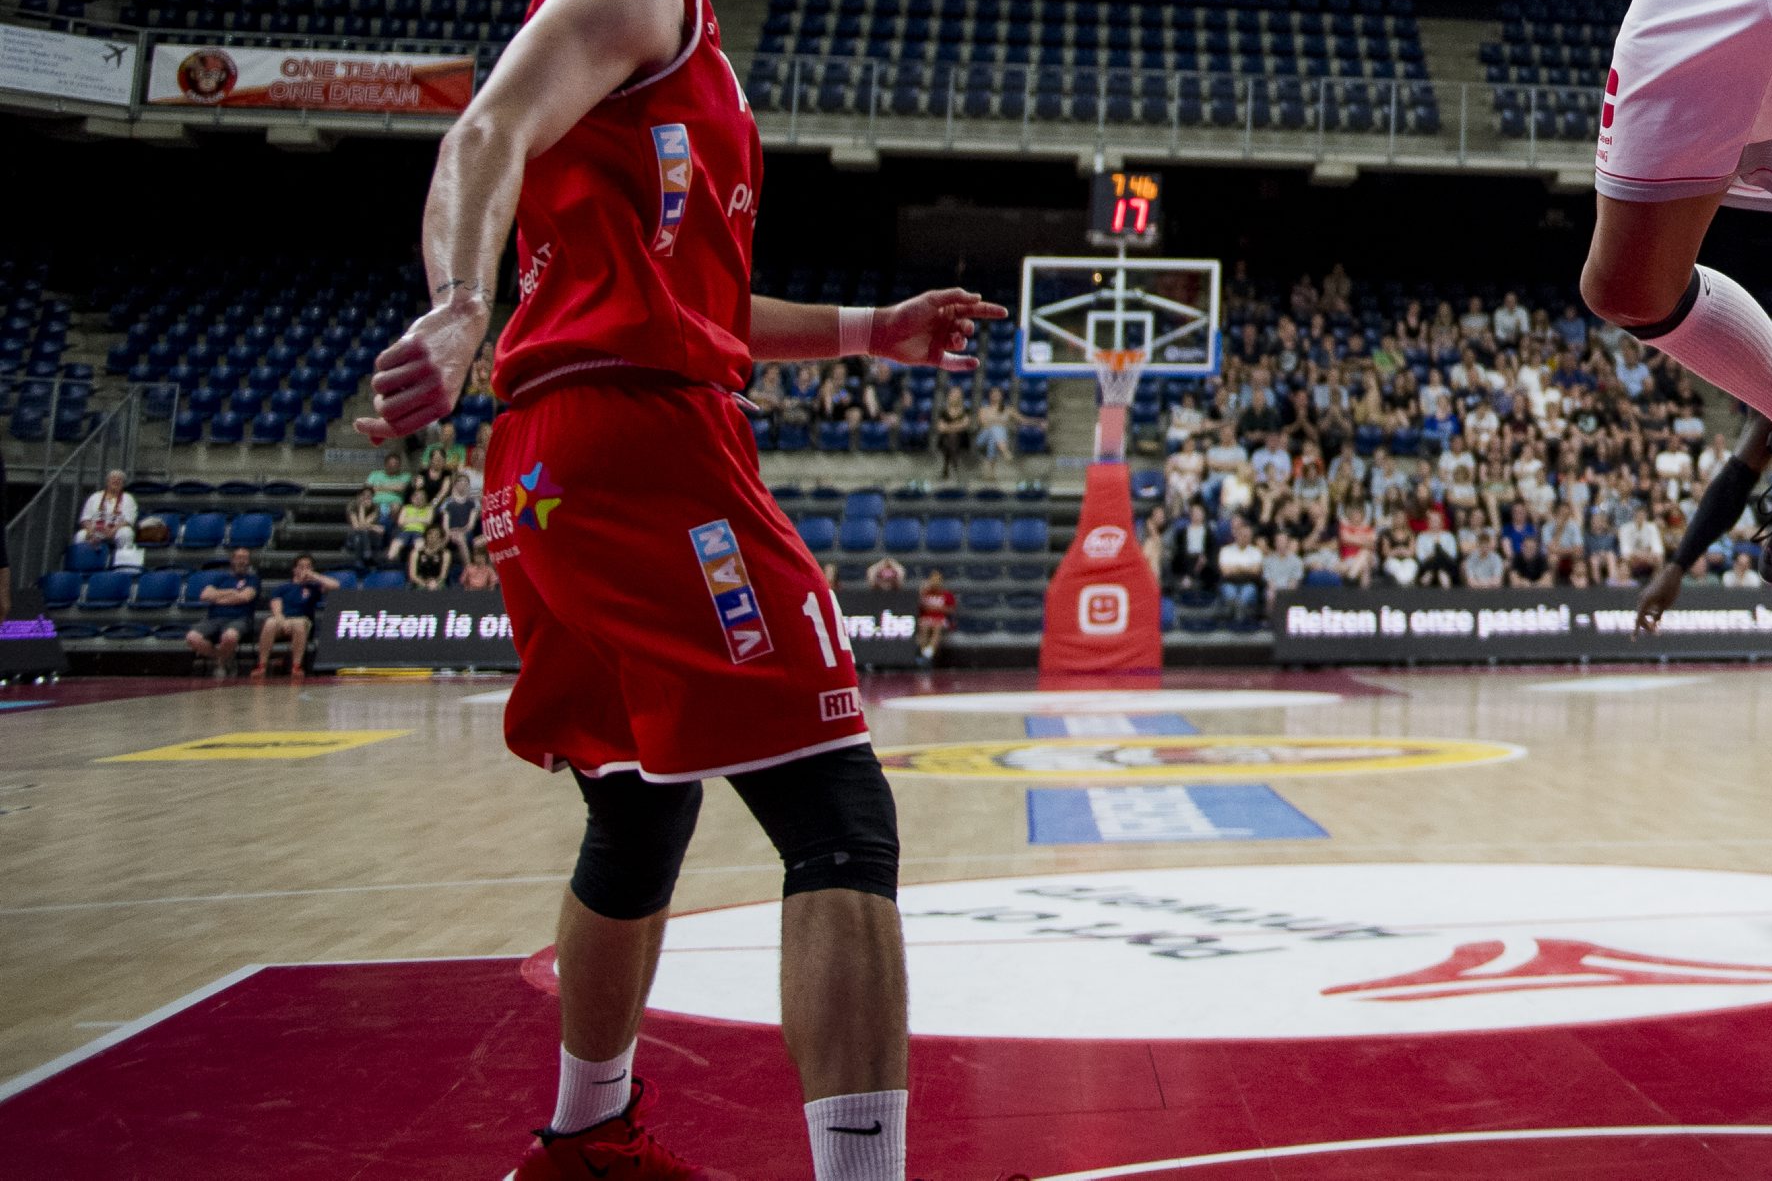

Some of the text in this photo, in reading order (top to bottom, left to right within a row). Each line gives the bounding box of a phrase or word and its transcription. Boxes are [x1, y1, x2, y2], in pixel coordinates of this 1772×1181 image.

[280, 57, 414, 84] ONE TEAM
[269, 80, 420, 106] ONE DREAM
[655, 129, 689, 253] VLAN
[1112, 198, 1150, 233] 17
[701, 522, 766, 659] VLAN
[337, 610, 437, 639] Reizen
[445, 610, 472, 638] is
[1287, 605, 1376, 636] Reizen
[1381, 605, 1407, 636] is
[1410, 608, 1474, 636] onze
[1477, 604, 1570, 641] passie!
[825, 692, 857, 716] RTL
